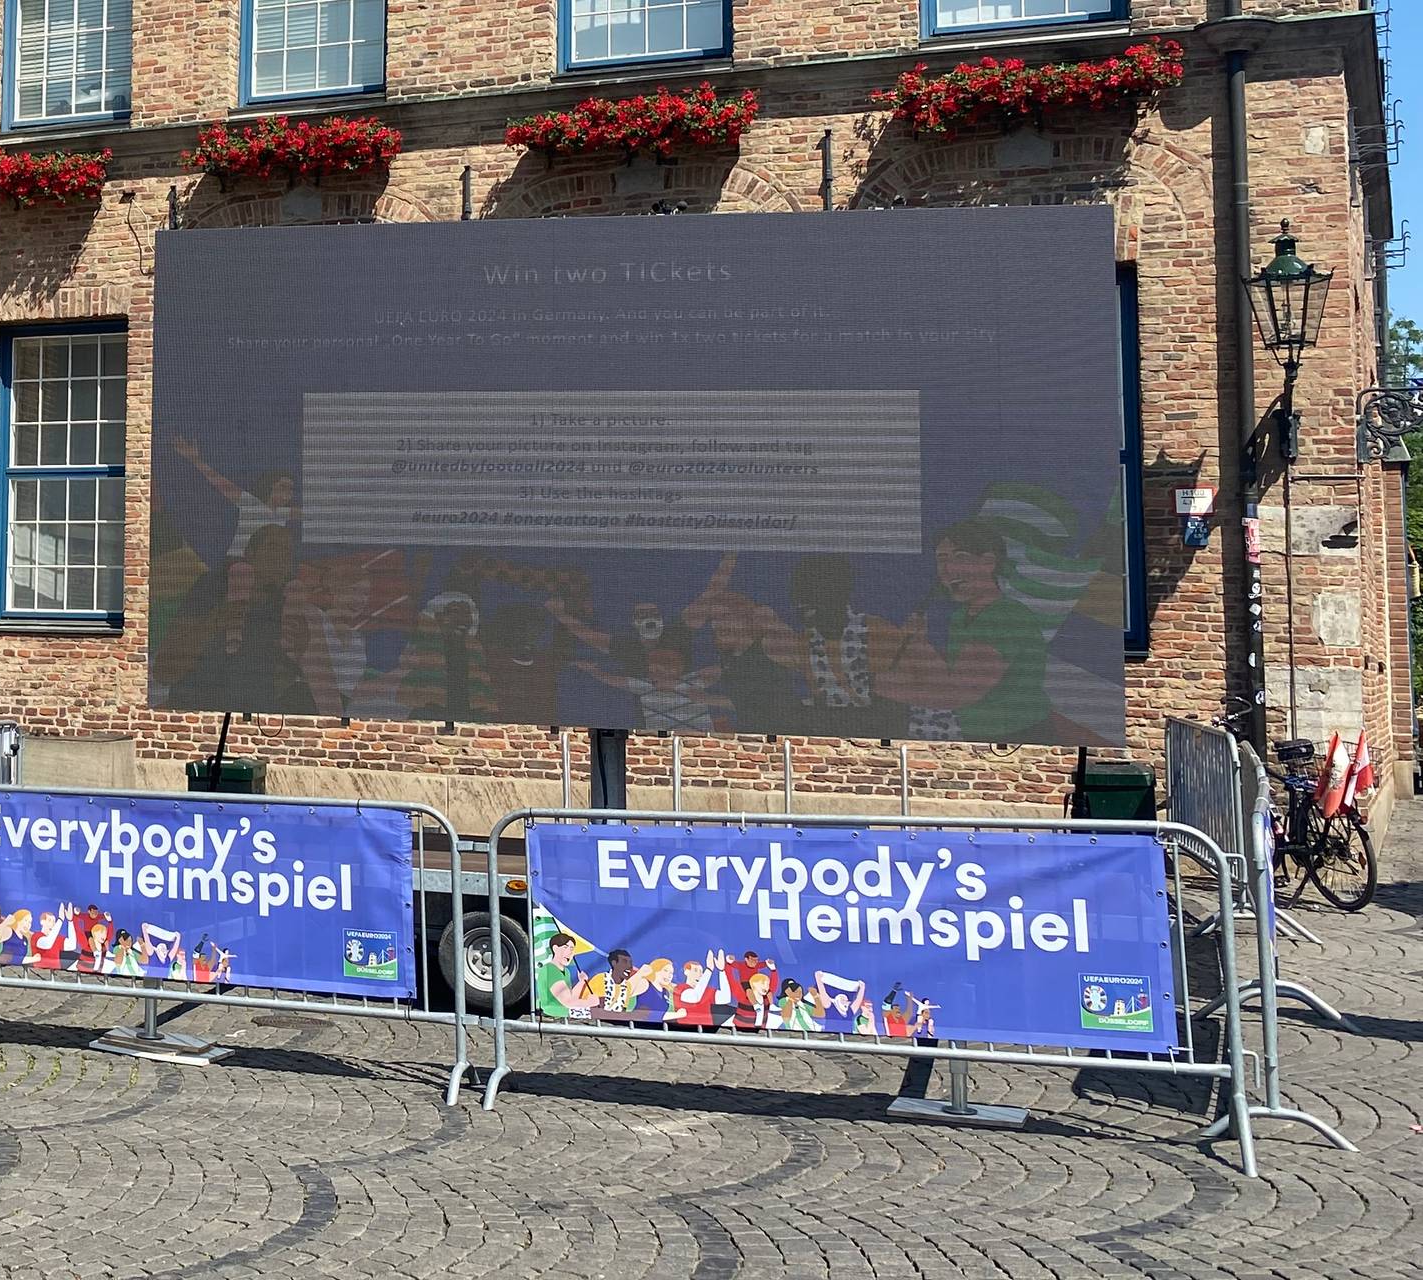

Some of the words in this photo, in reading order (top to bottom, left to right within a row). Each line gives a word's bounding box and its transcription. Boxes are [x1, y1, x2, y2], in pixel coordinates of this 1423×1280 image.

[483, 264, 539, 285] Win
[553, 265, 607, 285] two
[418, 310, 463, 324] EURO
[467, 309, 507, 323] 2024
[512, 308, 527, 321] in
[532, 307, 610, 324] Germany.
[615, 307, 647, 321] And
[653, 308, 683, 323] you
[688, 308, 717, 321] can
[723, 305, 744, 320] be
[749, 306, 785, 323] part
[790, 304, 809, 319] of
[228, 335, 269, 350] Share
[273, 337, 309, 352] your
[313, 334, 379, 351] personal
[427, 333, 462, 348] Year
[466, 332, 485, 347] To
[525, 333, 595, 346] moment
[599, 331, 630, 345] and
[635, 331, 664, 345] win
[670, 330, 690, 344] 1x
[694, 330, 726, 344] two
[731, 330, 787, 344] tickets
[792, 329, 818, 343] for
[823, 332, 833, 343] a
[838, 328, 890, 343] match
[897, 328, 915, 342] in
[919, 330, 960, 345] your
[530, 413, 545, 428] 1)
[551, 413, 587, 427] Take
[592, 416, 601, 427] a
[396, 438, 412, 453] 2)
[417, 438, 462, 451] Share
[466, 440, 502, 454] your
[507, 437, 566, 454] picture
[571, 441, 592, 452] on
[597, 438, 684, 455] Instagram,
[691, 438, 744, 453] follow
[748, 439, 780, 453] and
[785, 441, 814, 457] tag
[391, 459, 586, 475] @unitedbyfootball2024
[591, 460, 623, 474] und
[628, 460, 819, 476] @euro2024volunteers
[519, 486, 535, 501] 3)
[540, 486, 571, 499] Use
[577, 486, 603, 499] the
[608, 486, 683, 503] hashtags
[411, 511, 498, 525] #euro2024
[503, 511, 619, 528] #oneyeartogo
[625, 512, 799, 531] #hostcityDüsseldorf
[100, 850, 351, 917] Heimspiel
[597, 839, 987, 909] Everybody’s
[758, 889, 1090, 961] Heimspiel
